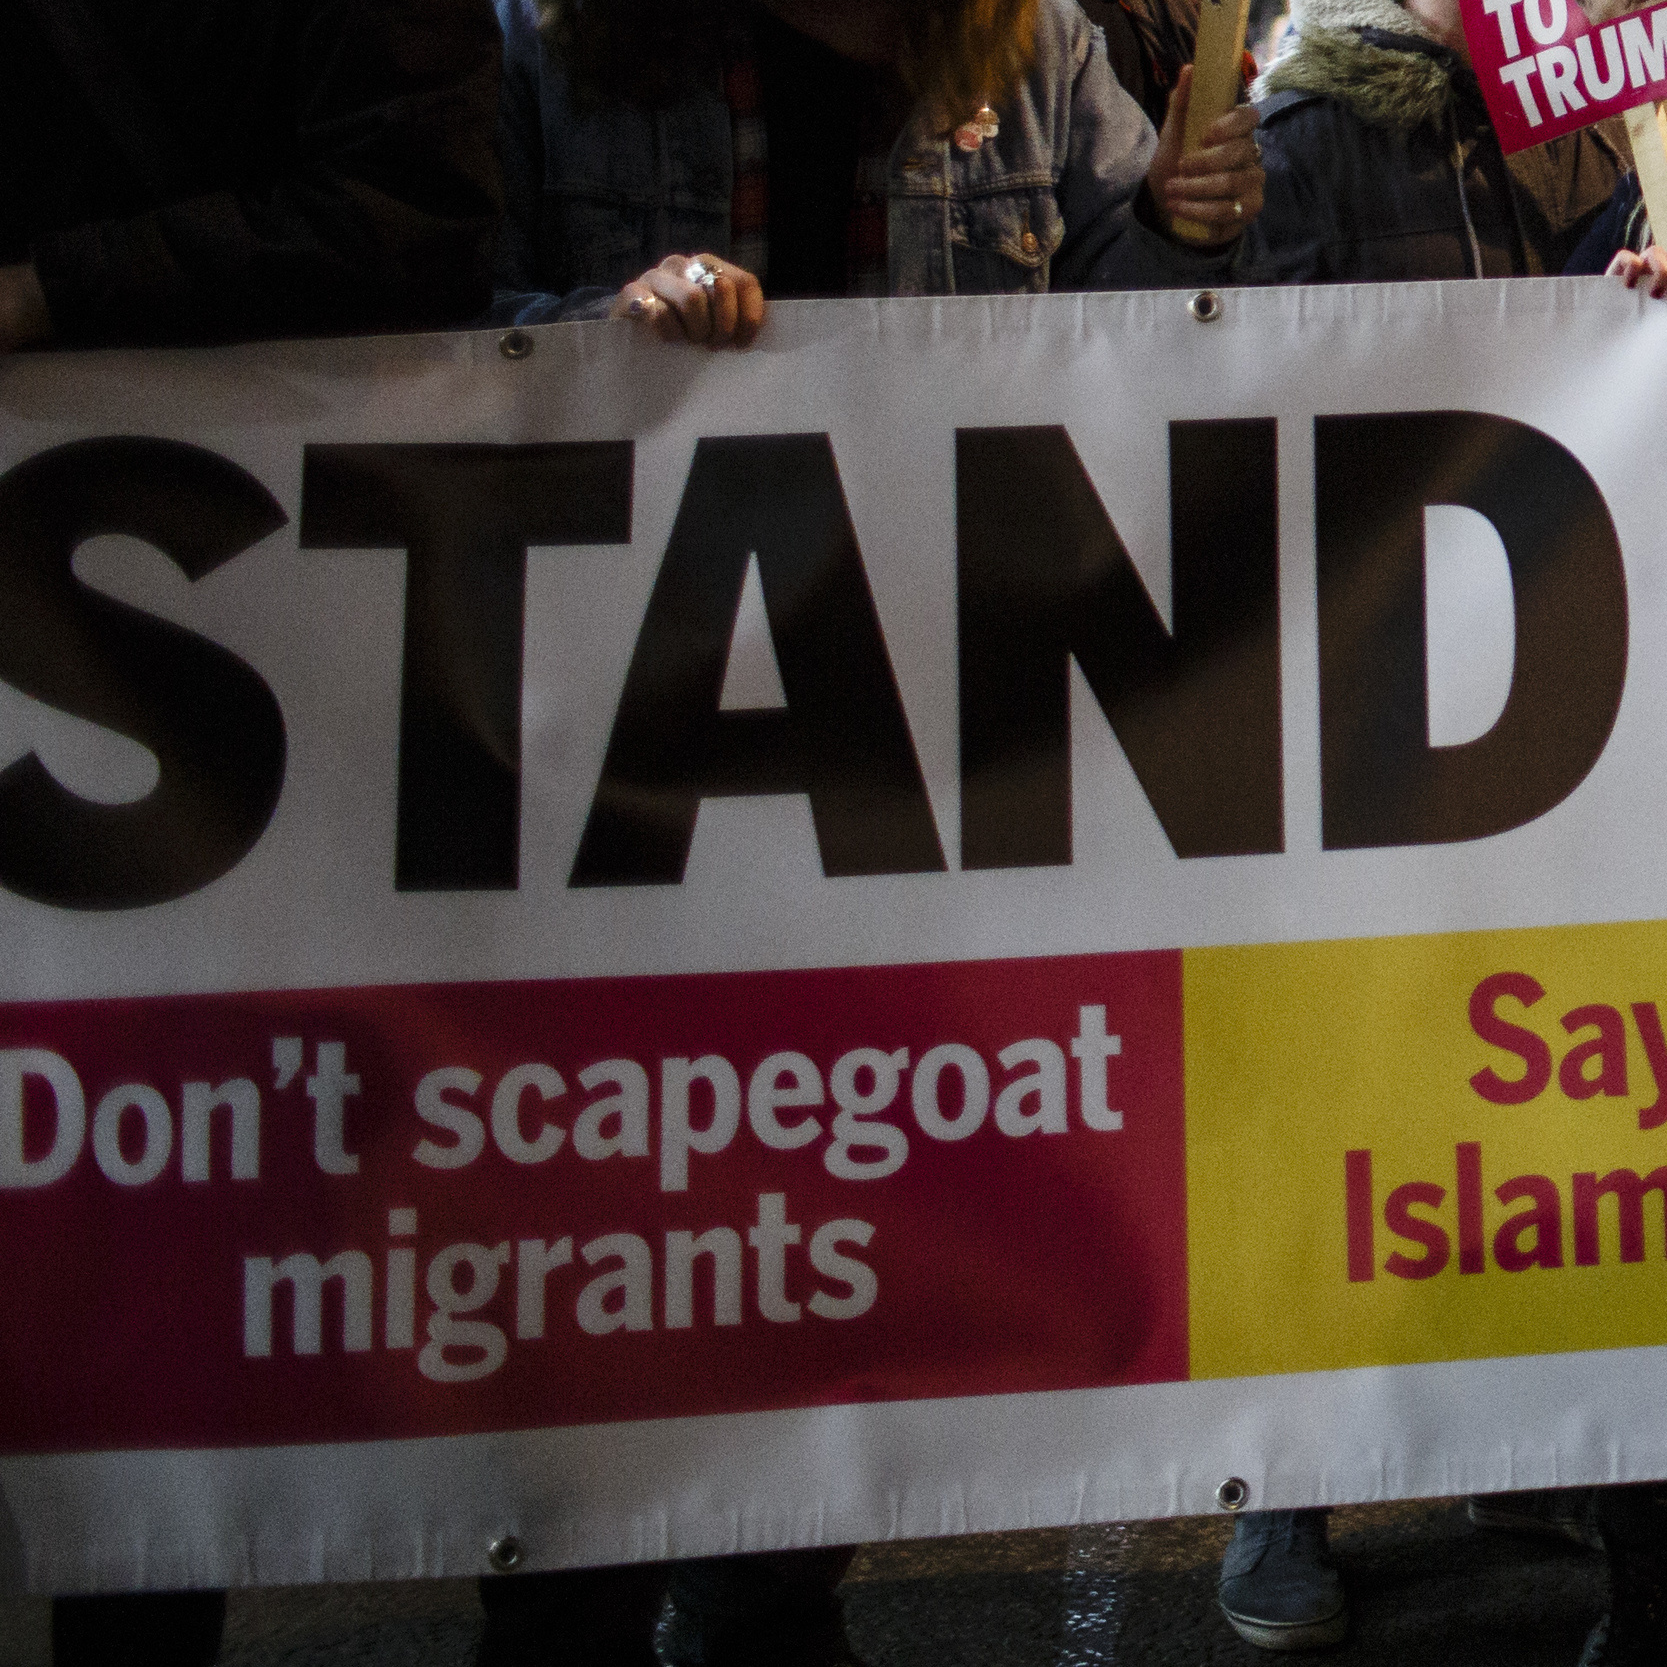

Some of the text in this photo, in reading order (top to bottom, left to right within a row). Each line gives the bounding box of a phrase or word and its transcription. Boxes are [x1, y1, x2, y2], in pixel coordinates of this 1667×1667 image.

[0, 409, 1629, 911] STAND
[0, 1005, 1123, 1192] Don’t scapegoat
[244, 1193, 878, 1383] migrants
